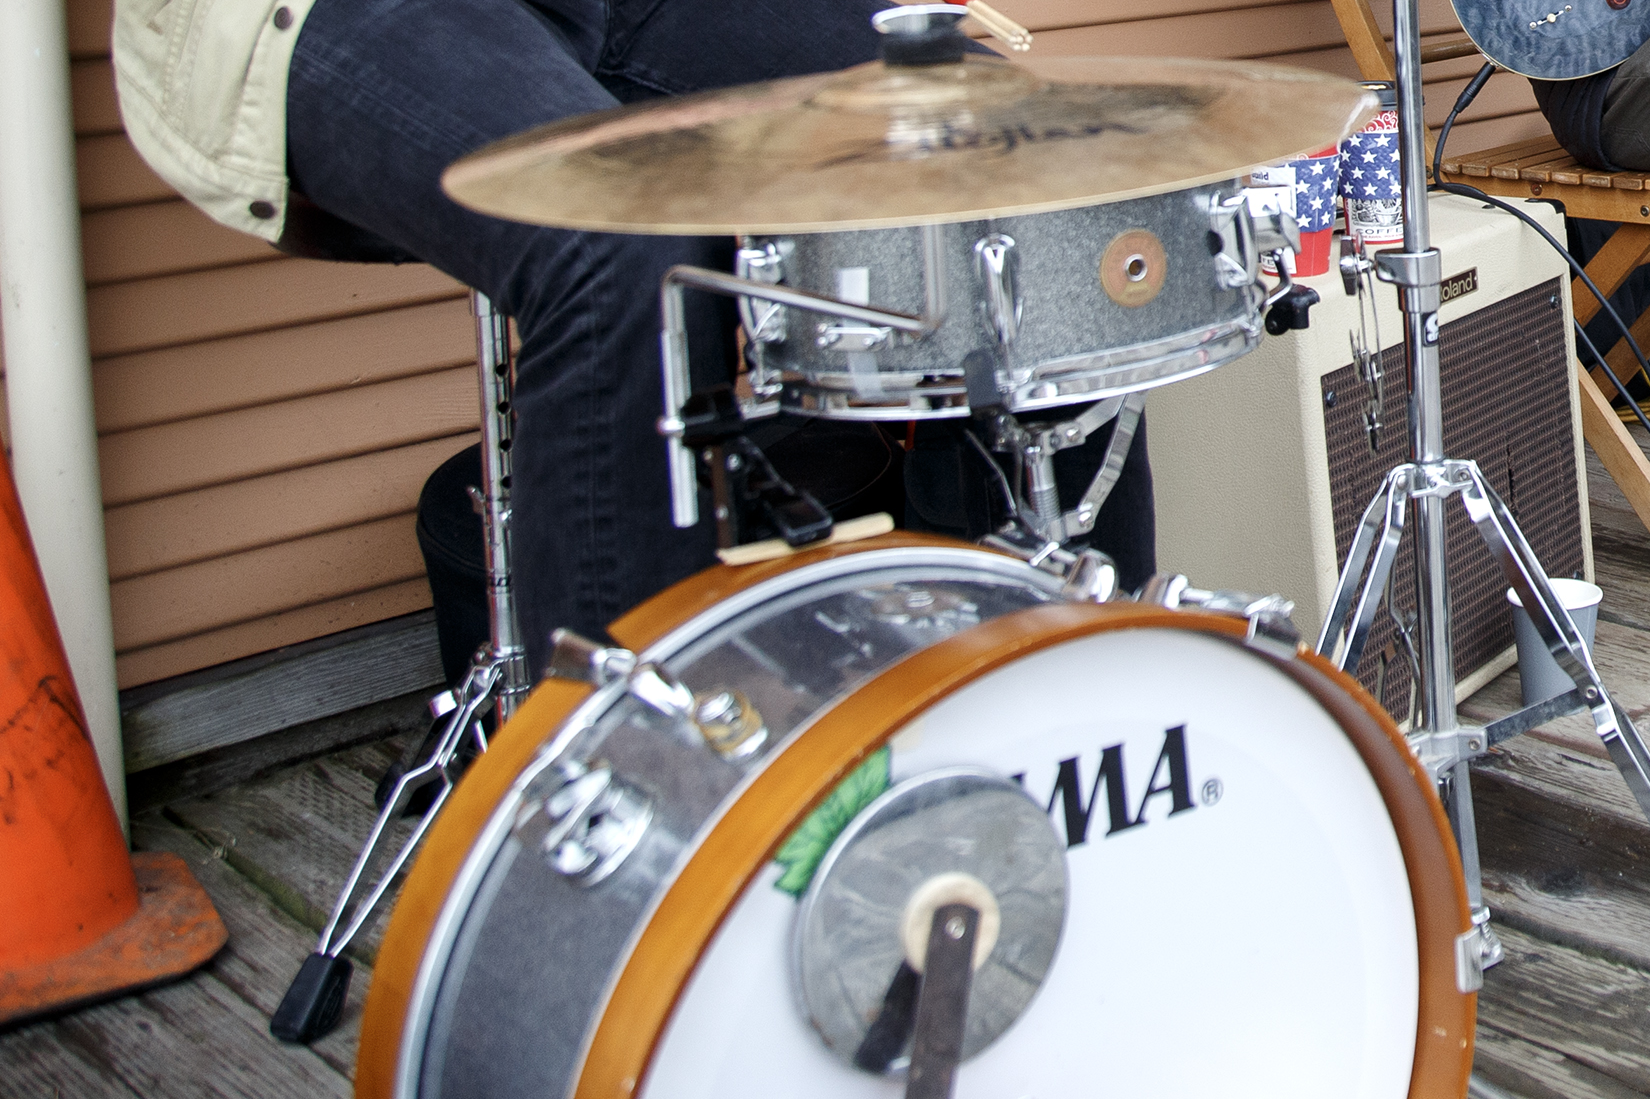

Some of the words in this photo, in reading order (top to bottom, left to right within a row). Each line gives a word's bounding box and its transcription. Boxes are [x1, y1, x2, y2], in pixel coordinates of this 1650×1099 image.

[1355, 227, 1403, 237] COFFE
[1441, 274, 1473, 301] oland
[1012, 724, 1197, 849] MA
